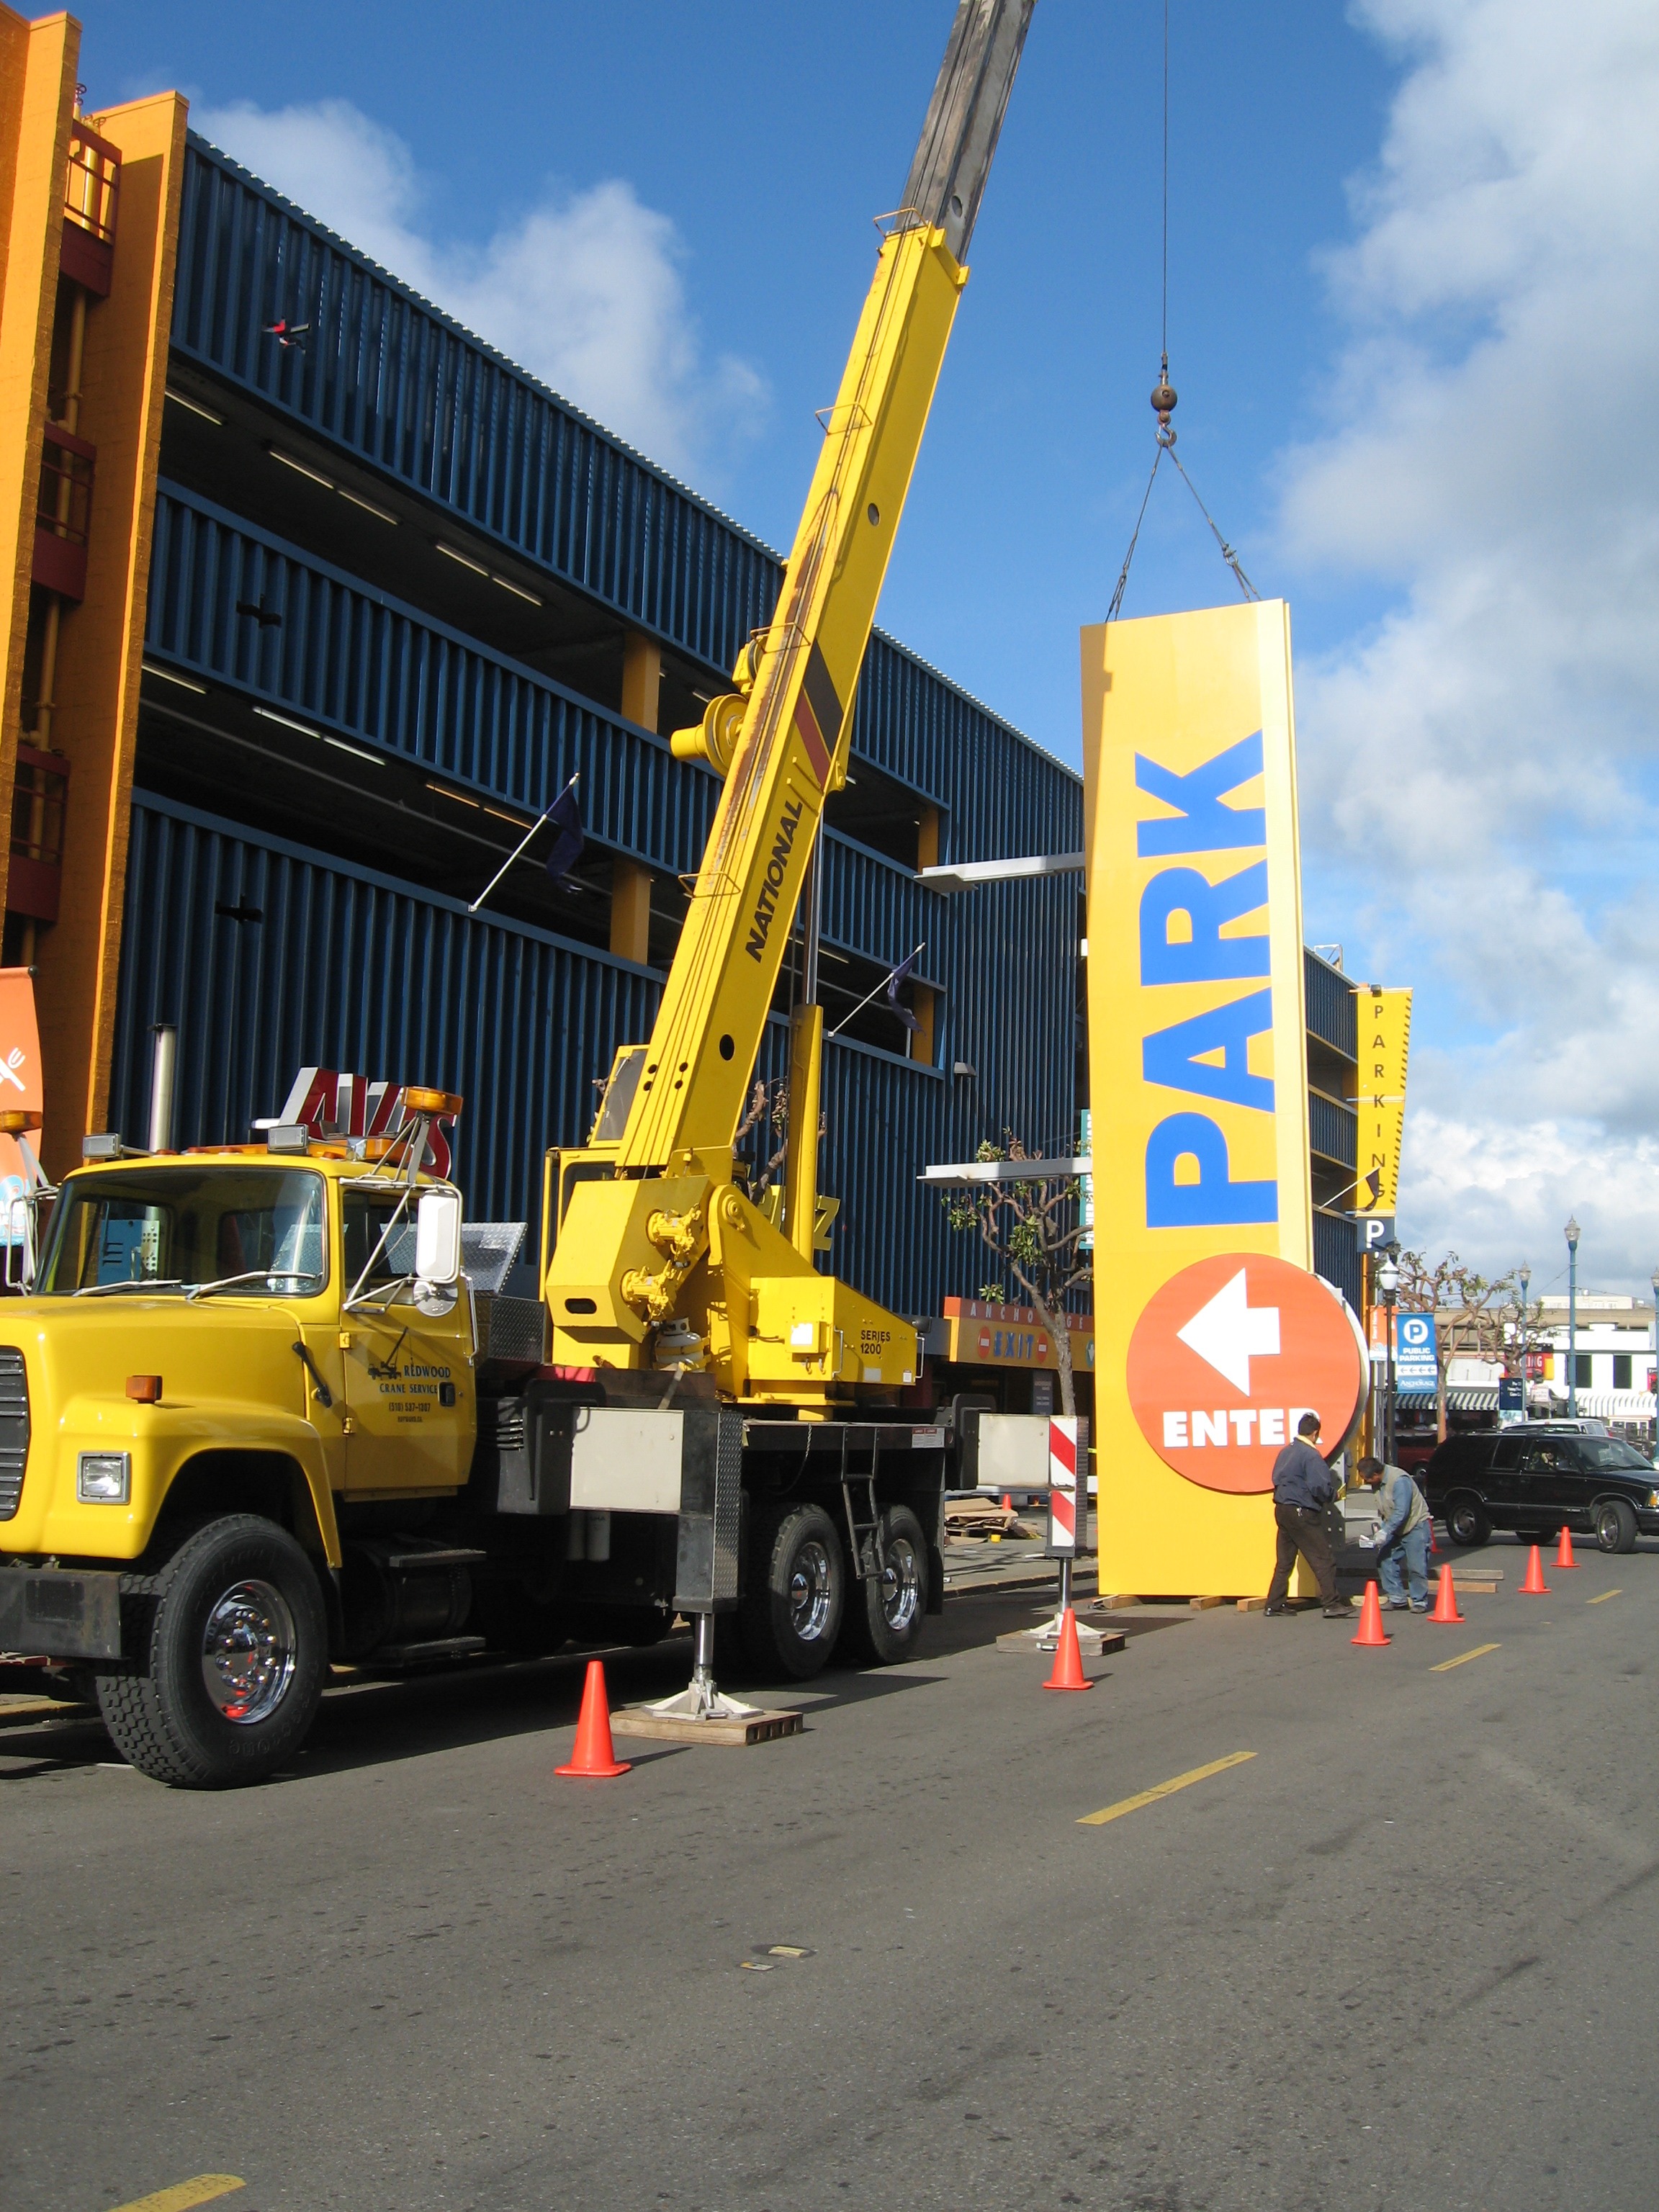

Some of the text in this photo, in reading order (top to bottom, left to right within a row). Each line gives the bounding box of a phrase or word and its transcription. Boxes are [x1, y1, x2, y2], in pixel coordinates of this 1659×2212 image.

[745, 800, 804, 963] NATIONAL
[1135, 728, 1278, 1228] PARK
[970, 1302, 1084, 1330] ANCHOGE
[860, 1330, 891, 1341] SERIES
[994, 1330, 1035, 1360] EXIT
[860, 1344, 882, 1354] 1200
[404, 1365, 451, 1378] REDWOOD
[379, 1383, 438, 1394] CRANE SERVICE
